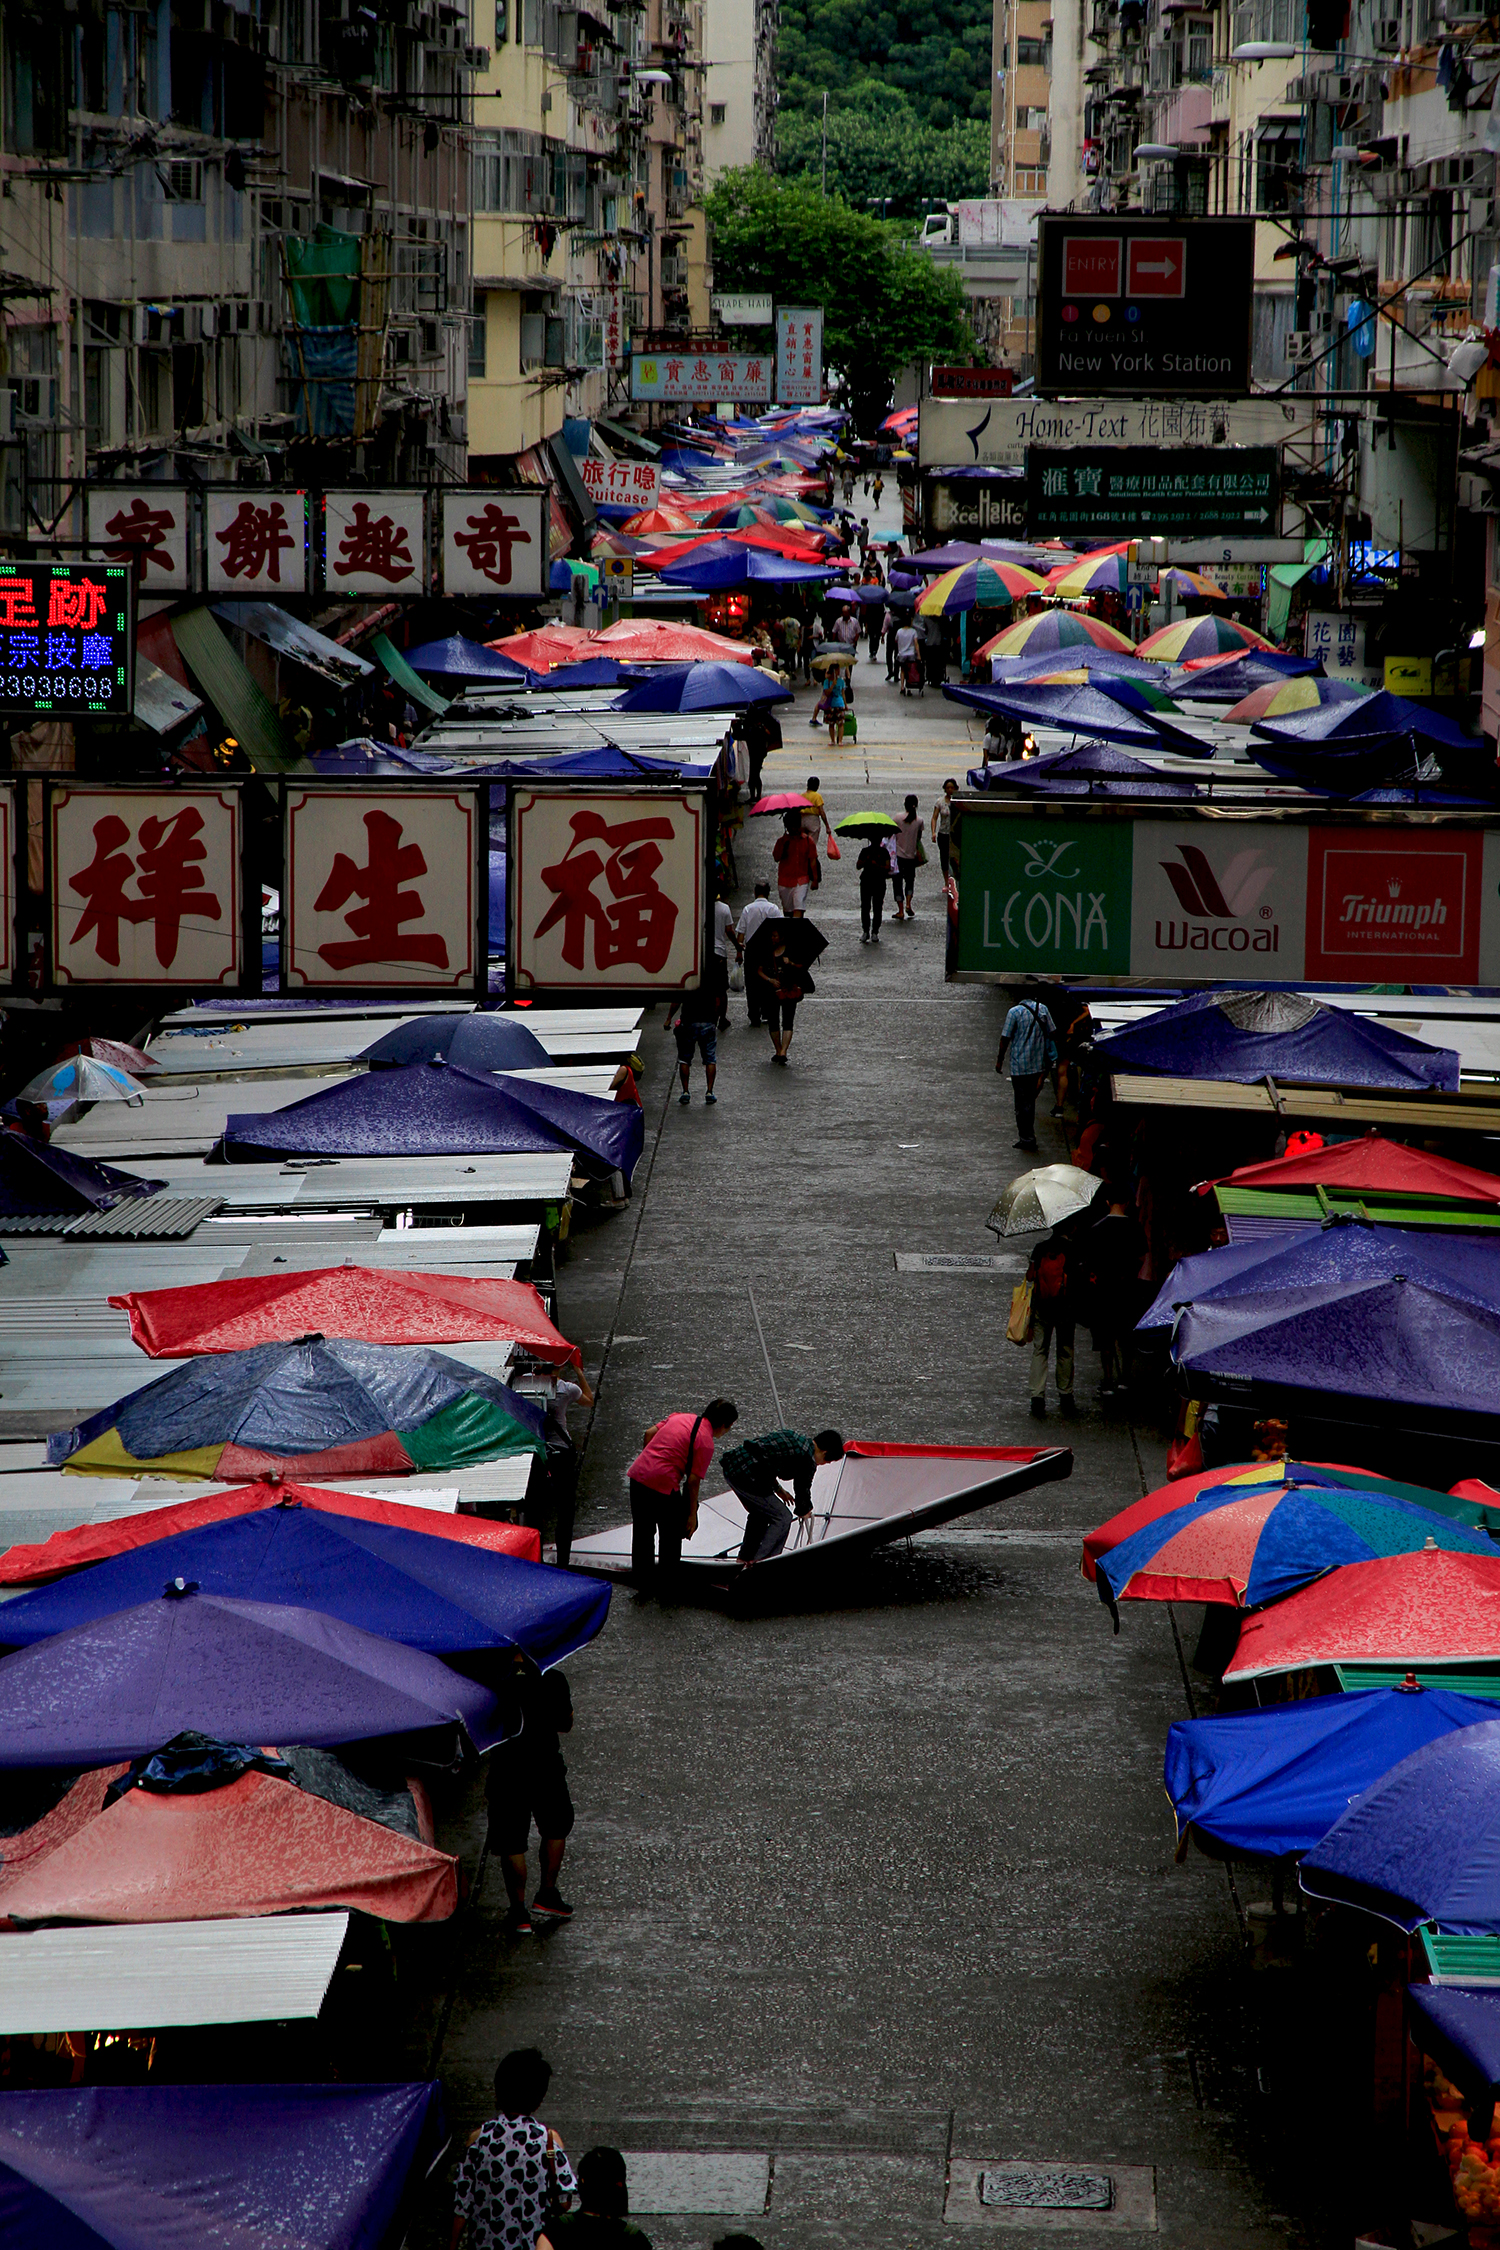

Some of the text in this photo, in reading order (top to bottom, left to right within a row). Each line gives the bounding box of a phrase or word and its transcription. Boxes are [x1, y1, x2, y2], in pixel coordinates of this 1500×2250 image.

[1068, 256, 1117, 271] ENTRY
[712, 298, 772, 308] SHAPE HAIR
[1059, 329, 1149, 343] Fa Yuen St.
[785, 322, 797, 376] 直銷中心
[663, 358, 767, 384] 實惠窗簾
[1058, 352, 1232, 372] New York Station
[1016, 403, 1129, 438] Home-Text
[582, 459, 655, 490] 旅行喼
[1109, 473, 1270, 491] 醫療用品配套有限公司
[586, 486, 648, 505] Suitcase
[1313, 621, 1357, 644] 花園
[0, 631, 113, 670] 宗按摩
[1311, 645, 1357, 667] 布藝
[982, 890, 1109, 950] LEONA
[1339, 894, 1448, 930] Triumph
[1155, 920, 1279, 952] Wacoal
[1346, 930, 1441, 941] INTERNATIONAL
